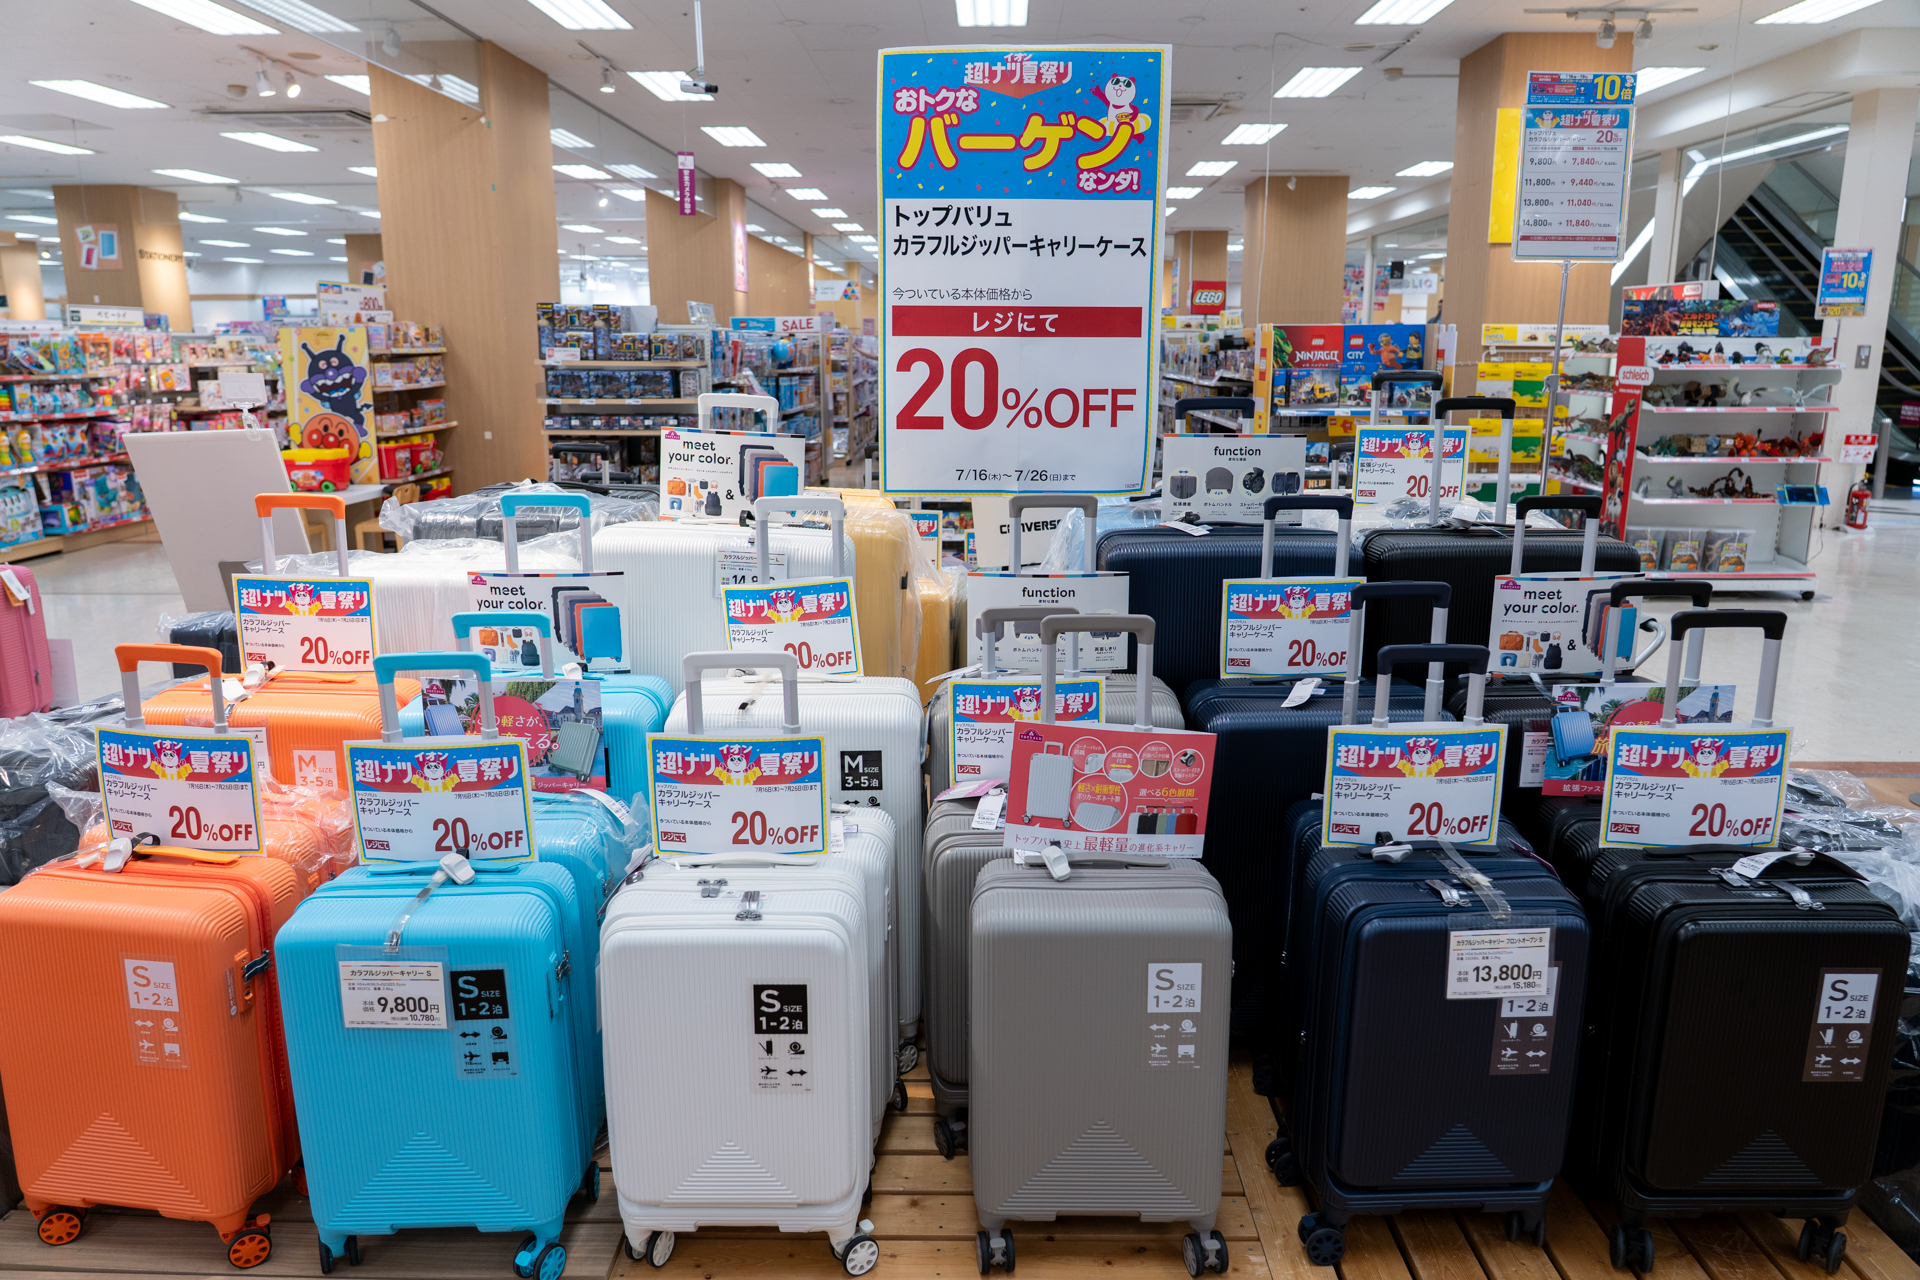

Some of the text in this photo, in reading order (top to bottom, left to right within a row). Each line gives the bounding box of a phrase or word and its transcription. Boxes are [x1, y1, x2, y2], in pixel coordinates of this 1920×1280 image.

[1004, 53, 1032, 61] イオン
[895, 87, 979, 112] おトクな
[898, 112, 1134, 171] バーゲン
[1078, 170, 1140, 192] なンダ!
[895, 205, 1012, 227] トップバリュ
[894, 235, 1147, 257] カラフルジッパーキャリーケース
[893, 288, 1033, 301] 今ついている本体価格から
[1193, 290, 1224, 305] LEGO
[782, 318, 813, 331] SALE
[973, 312, 1059, 333] レジにて
[1622, 370, 1649, 381] schleich
[896, 347, 1137, 430] 20%OFF
[683, 440, 715, 451] meet
[1214, 446, 1261, 456] function
[668, 452, 733, 465] your color.
[288, 583, 314, 591] イオン
[490, 585, 526, 596] meet
[1022, 587, 1076, 597] function
[1284, 586, 1311, 594] イオン
[770, 590, 795, 599] イオン
[1524, 589, 1562, 600] meet
[477, 598, 546, 611] your color.
[1315, 592, 1351, 611] 夏祭
[1503, 602, 1579, 616] your color.
[243, 626, 284, 634] キャリーケース
[247, 653, 266, 661] レジにて
[300, 637, 369, 664] 20%OFF
[1288, 639, 1349, 667] 20%OF
[1013, 687, 1041, 695] イオン
[298, 755, 316, 772] M
[845, 755, 863, 773] M
[106, 779, 157, 792] カラフルジッパー
[845, 776, 879, 787] 3-5泊
[1335, 783, 1401, 791] カラフルジッパー
[107, 789, 151, 800] キャリーケース
[658, 790, 720, 799] カラフルジッパー
[1139, 787, 1194, 797] 選べる6色展開
[359, 798, 419, 807] カラフルジッパー
[658, 799, 711, 808] キャリーケース
[360, 807, 411, 816] キャリーケース
[169, 806, 252, 841] 20%OFF
[1407, 802, 1489, 835] 20%OFF
[113, 820, 132, 832] レジにて
[732, 811, 819, 845] 20%OFF
[433, 818, 523, 851] 20%OFF
[366, 840, 389, 849] レジにて
[1456, 938, 1505, 946] カラフルジッパーキャリー
[1506, 937, 1538, 945] フロントオープン
[132, 966, 151, 987] S
[1155, 969, 1175, 990] S
[1473, 964, 1542, 983] 13,800円
[458, 976, 479, 998] S
[1829, 980, 1849, 1001] S
[134, 992, 173, 1007] 1-2泊
[377, 996, 439, 1014] 9,800円
[760, 989, 781, 1013] S
[1154, 995, 1195, 1008] 1-2泊
[1508, 1000, 1549, 1012] 1-2泊
[459, 1002, 503, 1015] 1-2泊
[1825, 1006, 1866, 1018] 1-2泊
[759, 1016, 803, 1030] 1-2泊
